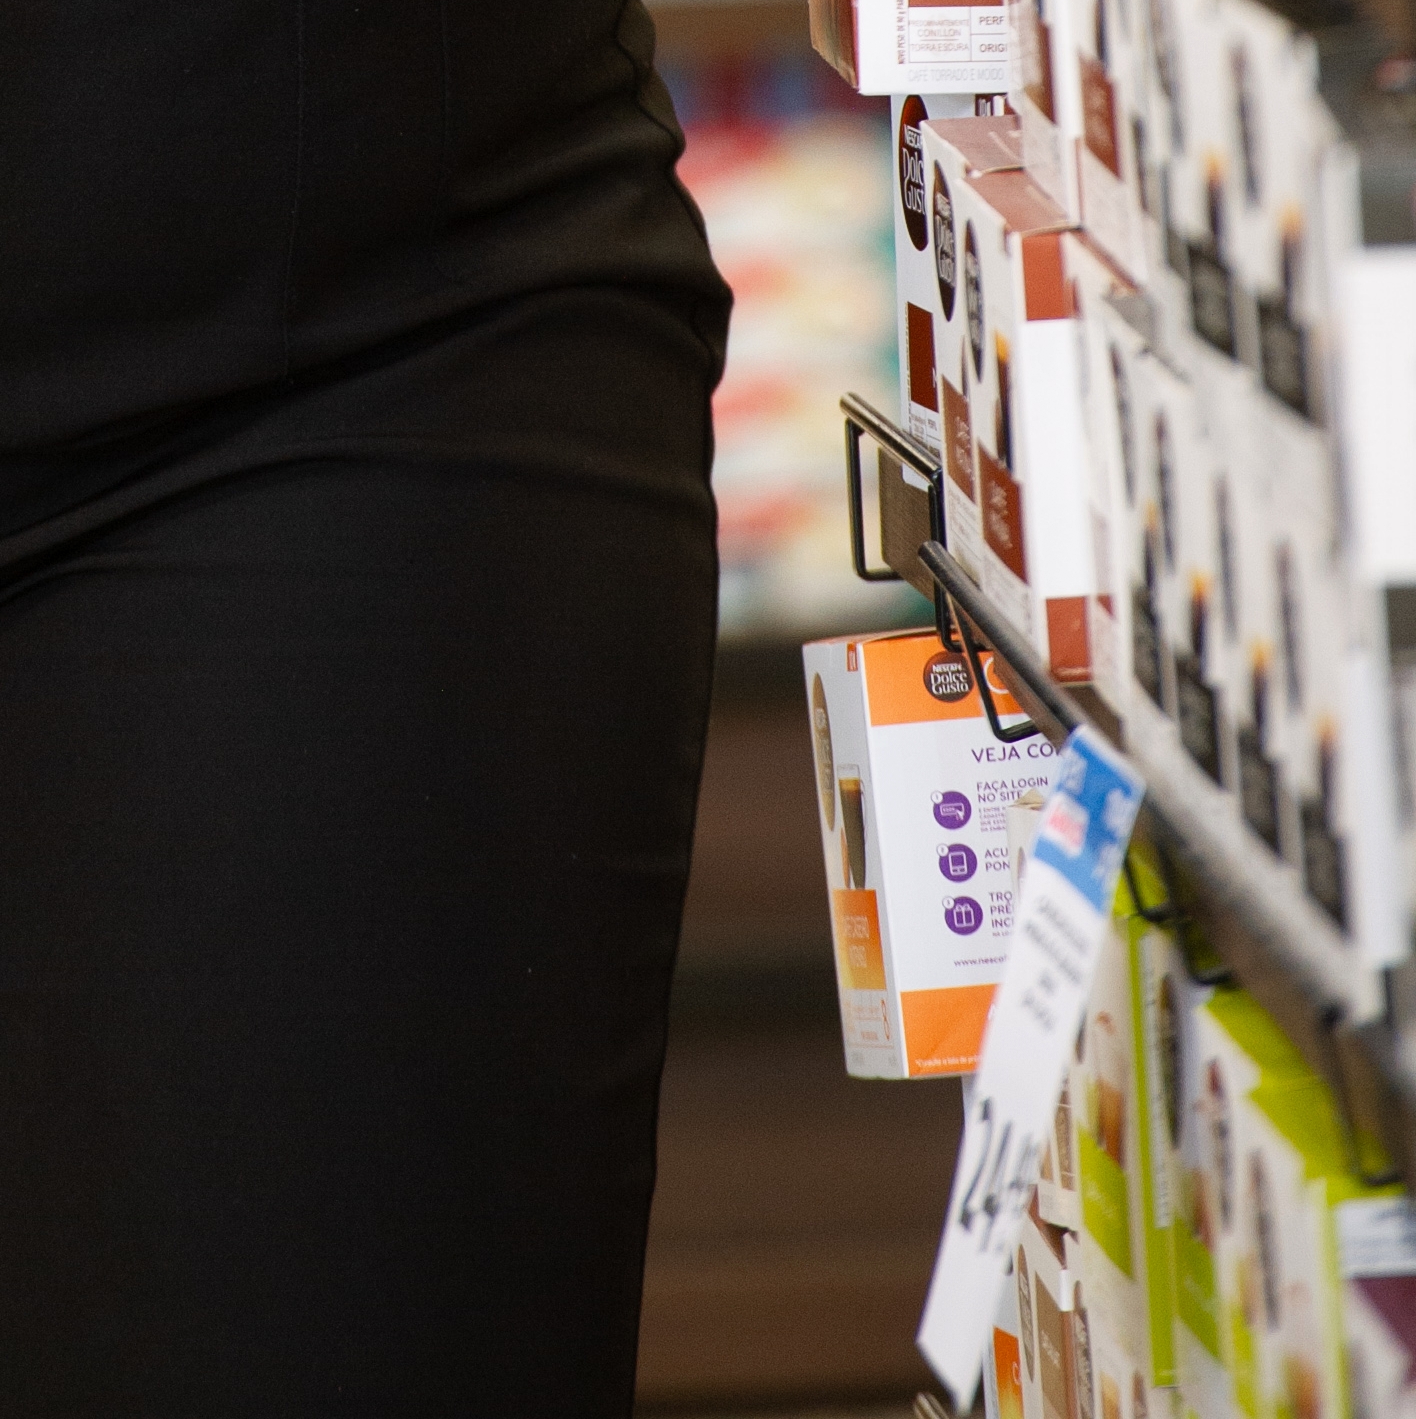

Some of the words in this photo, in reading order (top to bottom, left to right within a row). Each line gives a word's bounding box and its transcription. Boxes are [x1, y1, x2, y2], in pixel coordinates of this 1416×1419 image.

[979, 15, 1005, 26] PERF
[902, 148, 924, 186] Dolc
[905, 178, 926, 215] Gust
[930, 671, 968, 685] Dolce
[931, 681, 970, 695] Gusto
[971, 745, 1021, 763] VEJA
[1027, 742, 1061, 758] CO
[976, 779, 1009, 793] FAÇA
[1011, 776, 1049, 789] LOGIN
[978, 792, 996, 803] NO
[999, 790, 1023, 802] SITE
[984, 847, 1009, 859] ACU
[985, 860, 1011, 872] PON
[989, 891, 1013, 902] TRO
[990, 900, 1013, 915] PRÊ
